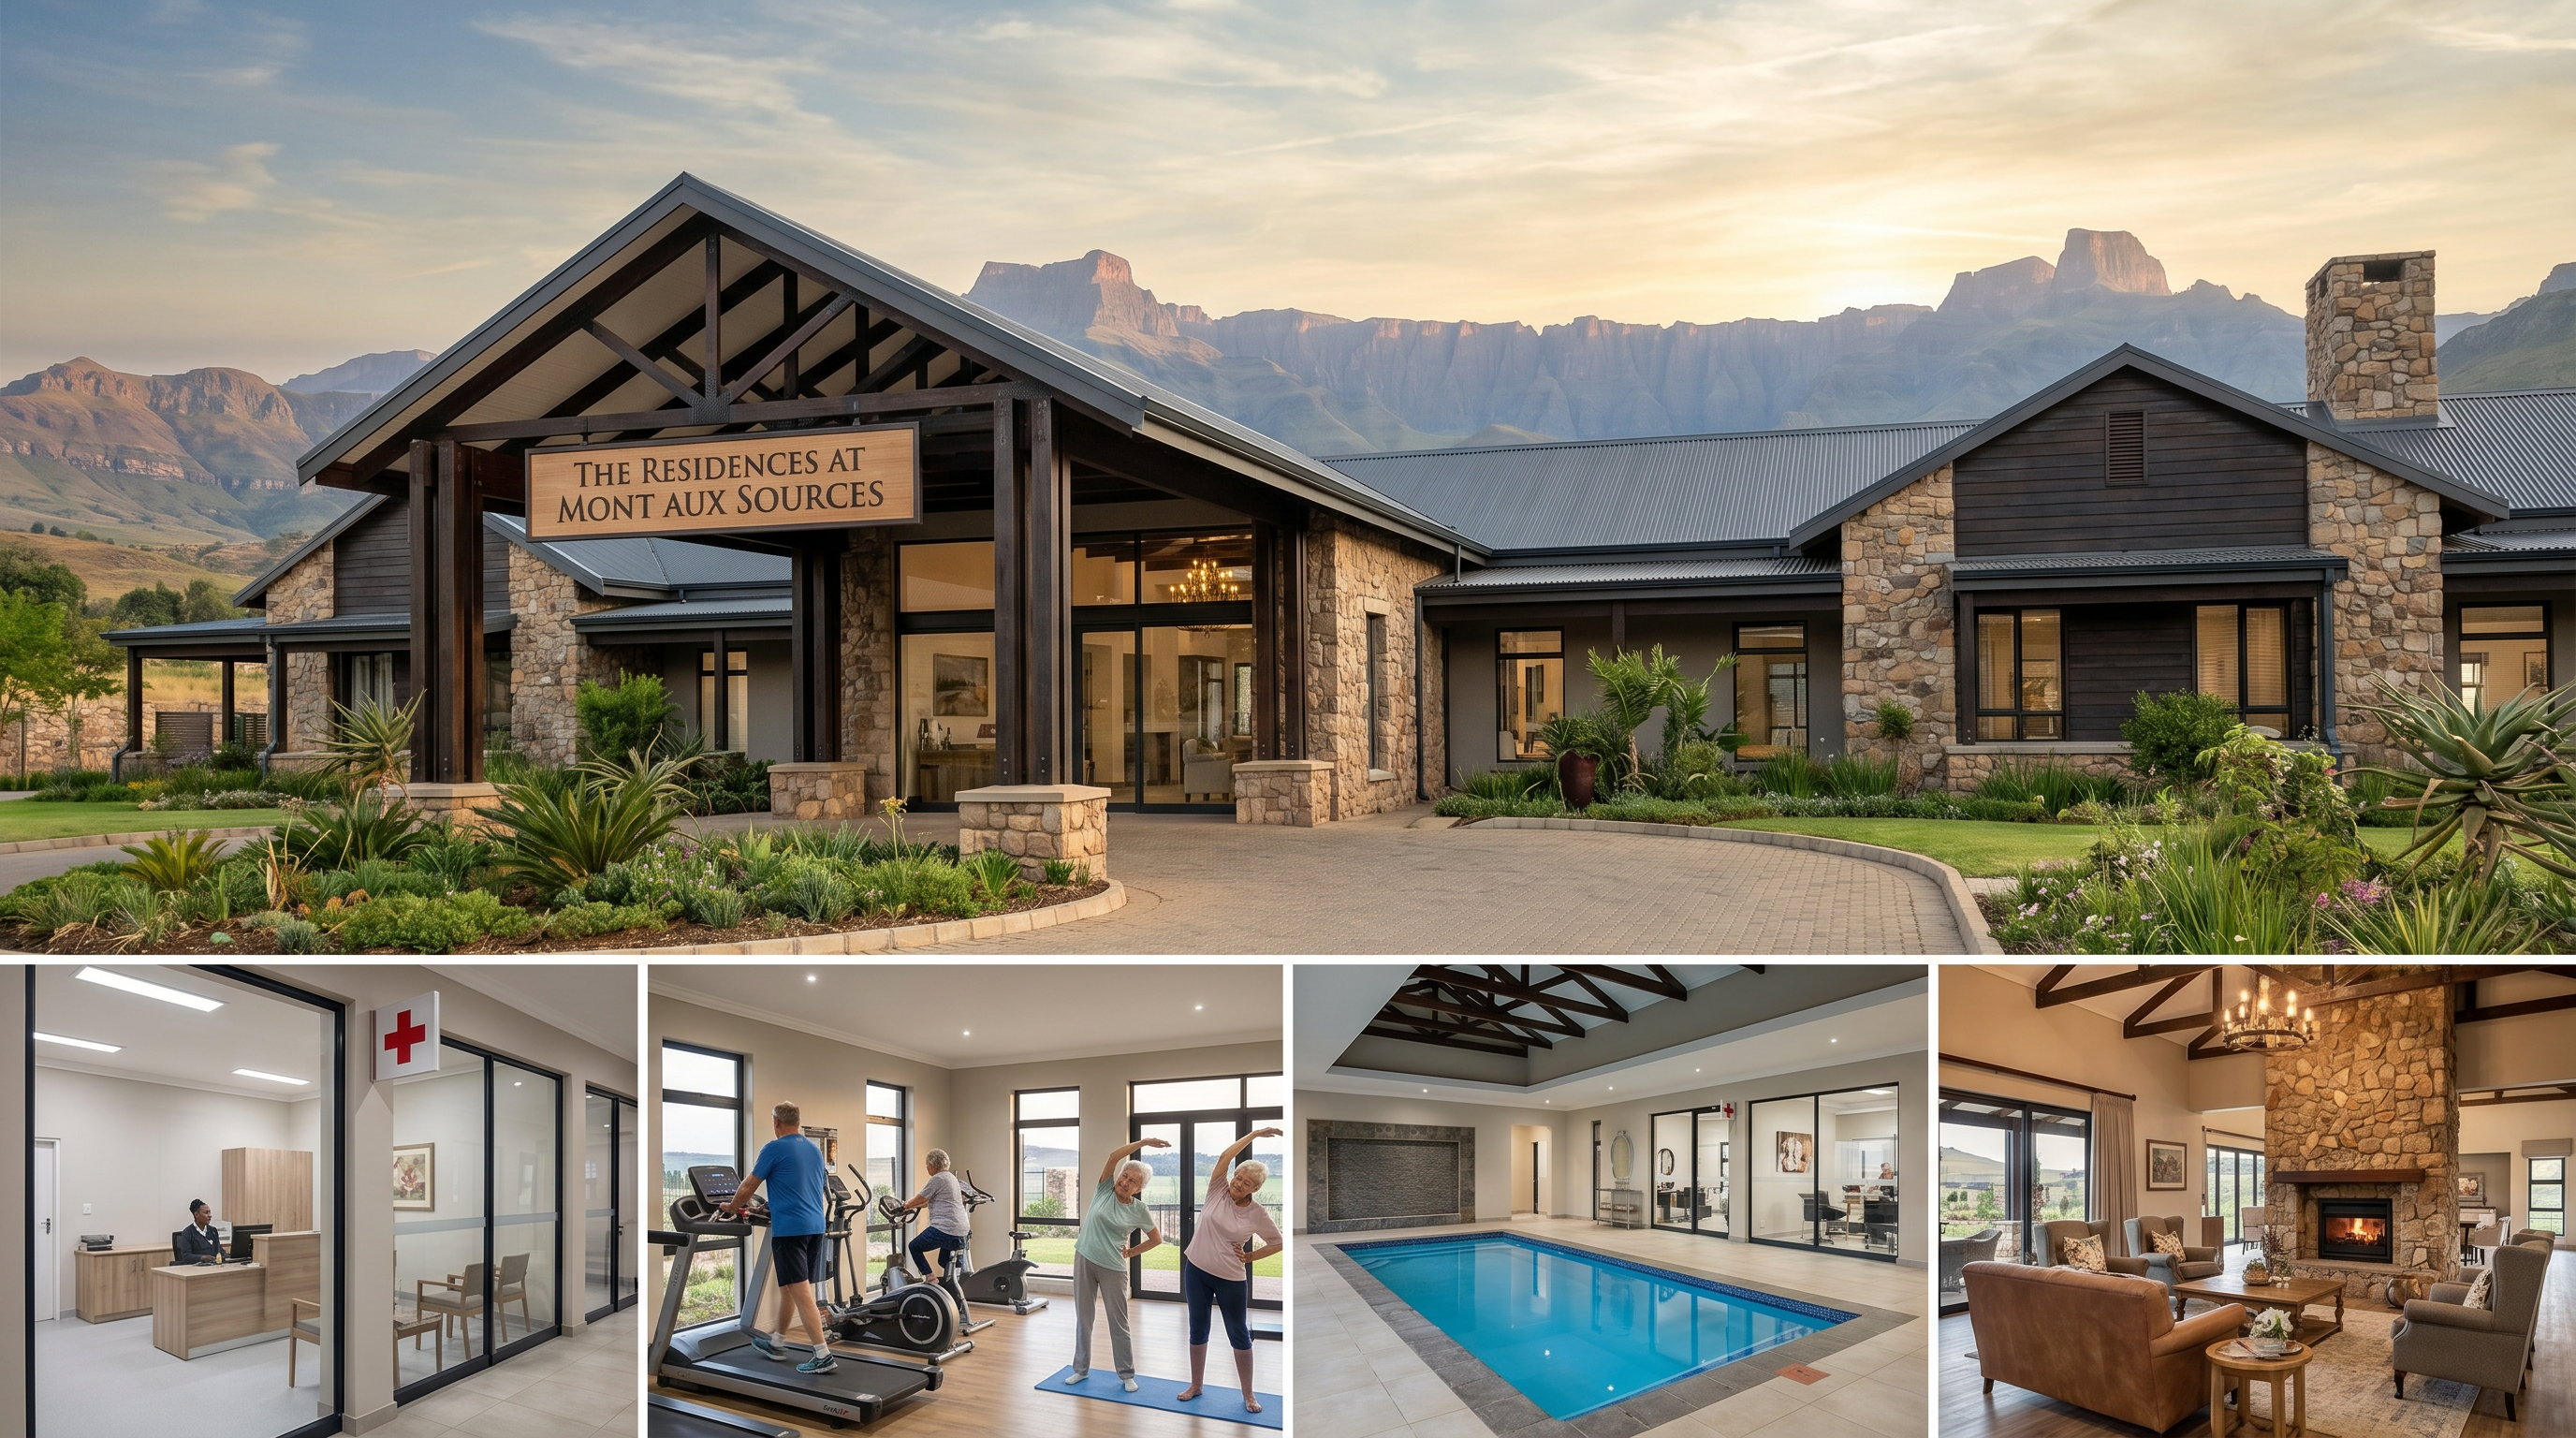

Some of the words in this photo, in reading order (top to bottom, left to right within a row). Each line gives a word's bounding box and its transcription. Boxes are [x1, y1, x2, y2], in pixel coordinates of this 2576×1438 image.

[573, 461, 631, 488] THE
[641, 449, 819, 484] RESIDENCES
[827, 447, 866, 473] AT
[556, 493, 655, 523] MONT
[663, 490, 727, 518] AUX
[737, 480, 884, 515] SOURCES
